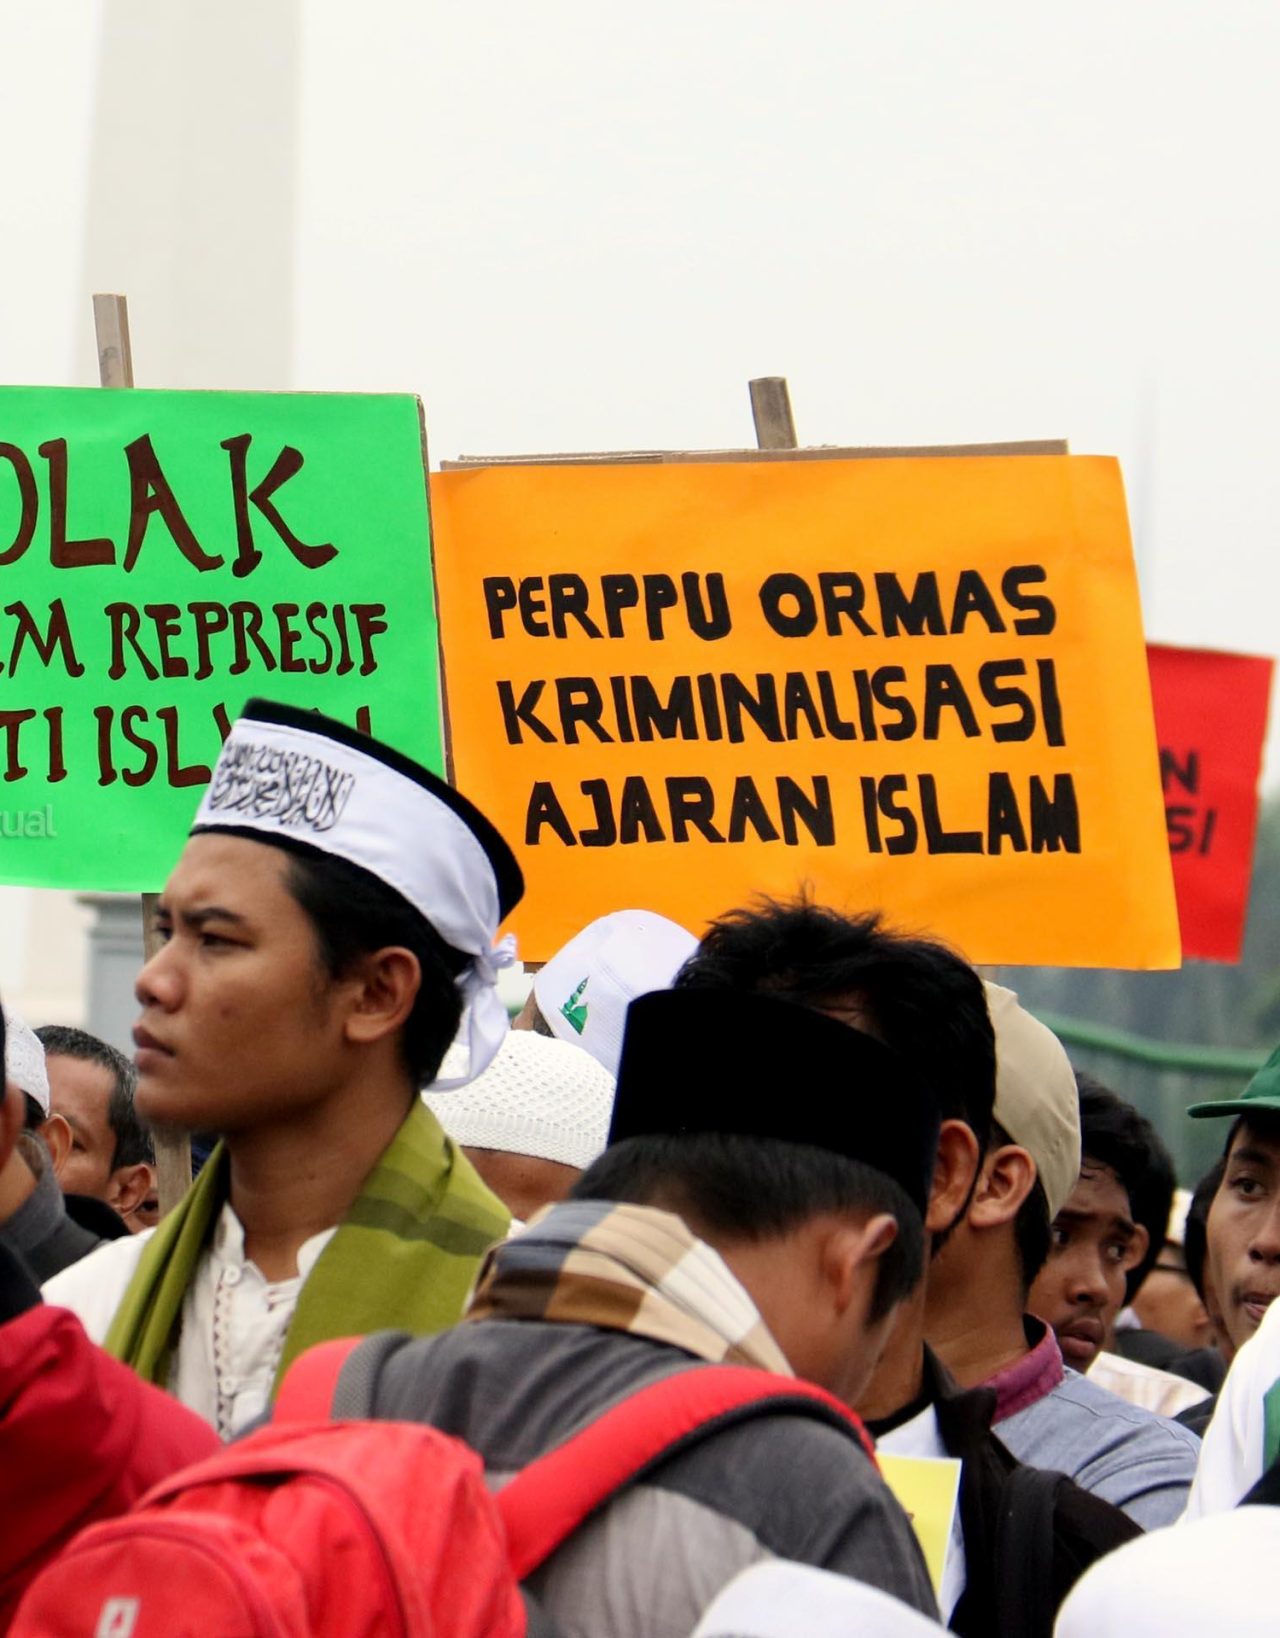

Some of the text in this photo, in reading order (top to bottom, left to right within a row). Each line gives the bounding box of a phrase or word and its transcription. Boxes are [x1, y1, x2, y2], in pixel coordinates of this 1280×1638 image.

[104, 601, 388, 681] REPRESIF
[483, 565, 1056, 641] PERPPU ORMAS
[497, 659, 1065, 747] KRIMINALISASI
[94, 703, 370, 788] ISL
[526, 772, 1080, 855] AJARAN ISLAM
